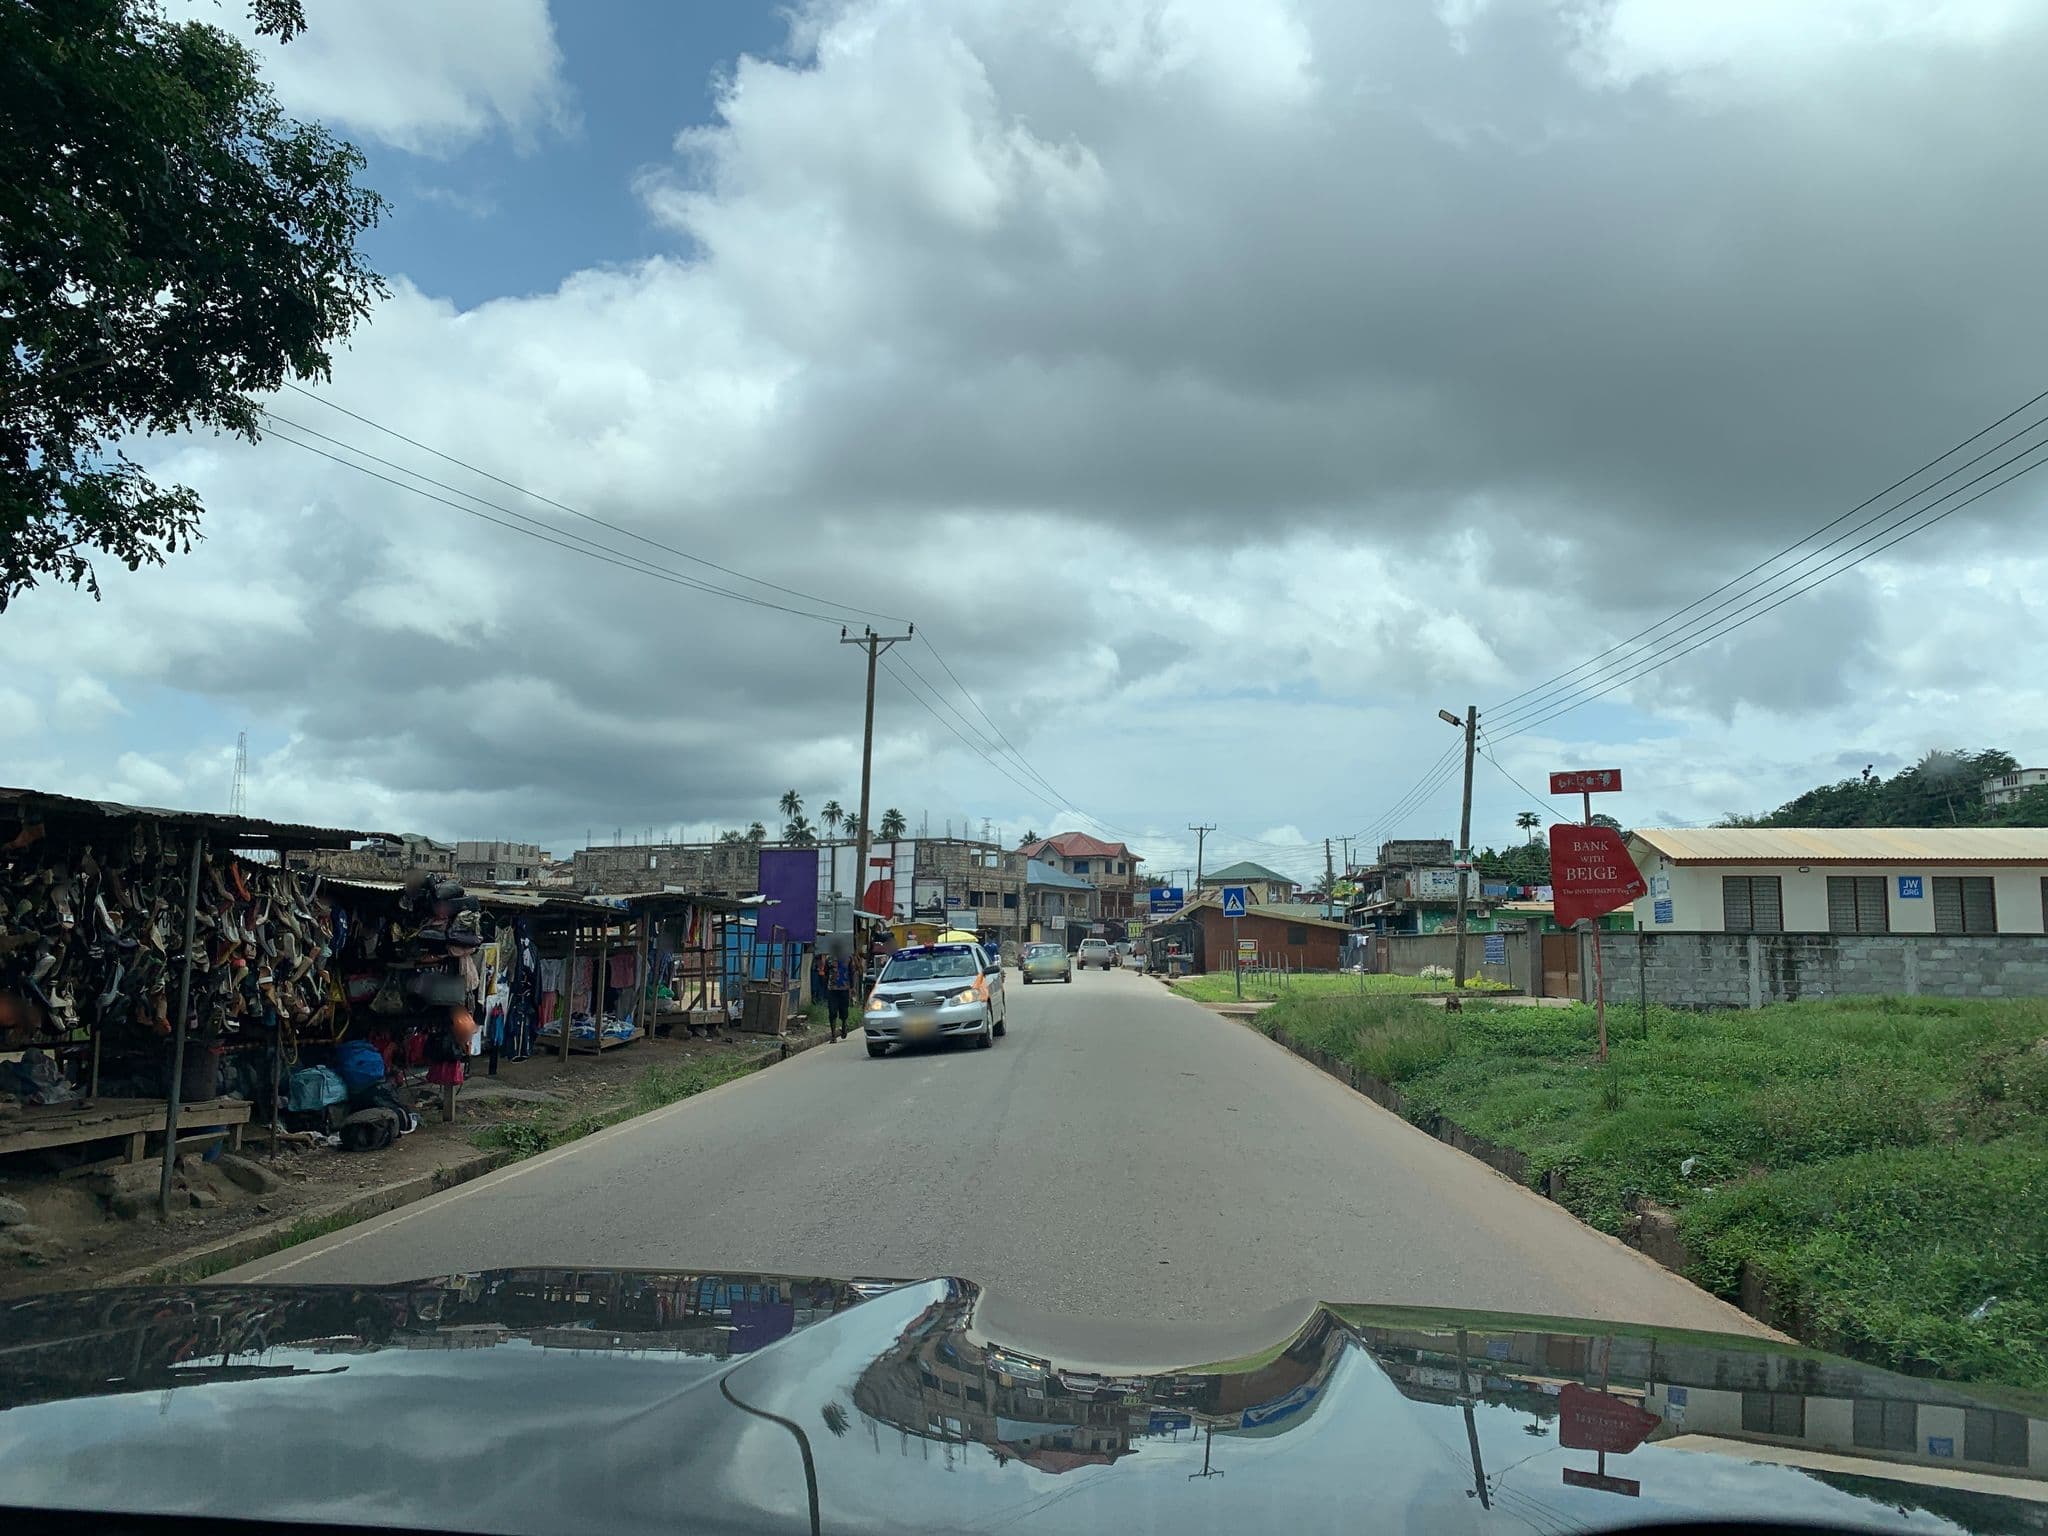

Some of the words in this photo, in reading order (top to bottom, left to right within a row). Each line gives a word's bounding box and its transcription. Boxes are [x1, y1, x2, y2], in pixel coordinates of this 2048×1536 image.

[1573, 840, 1609, 851] BANK
[1580, 855, 1606, 863] WITH
[1566, 866, 1618, 881] BEIGE
[1903, 879, 1919, 888] JW
